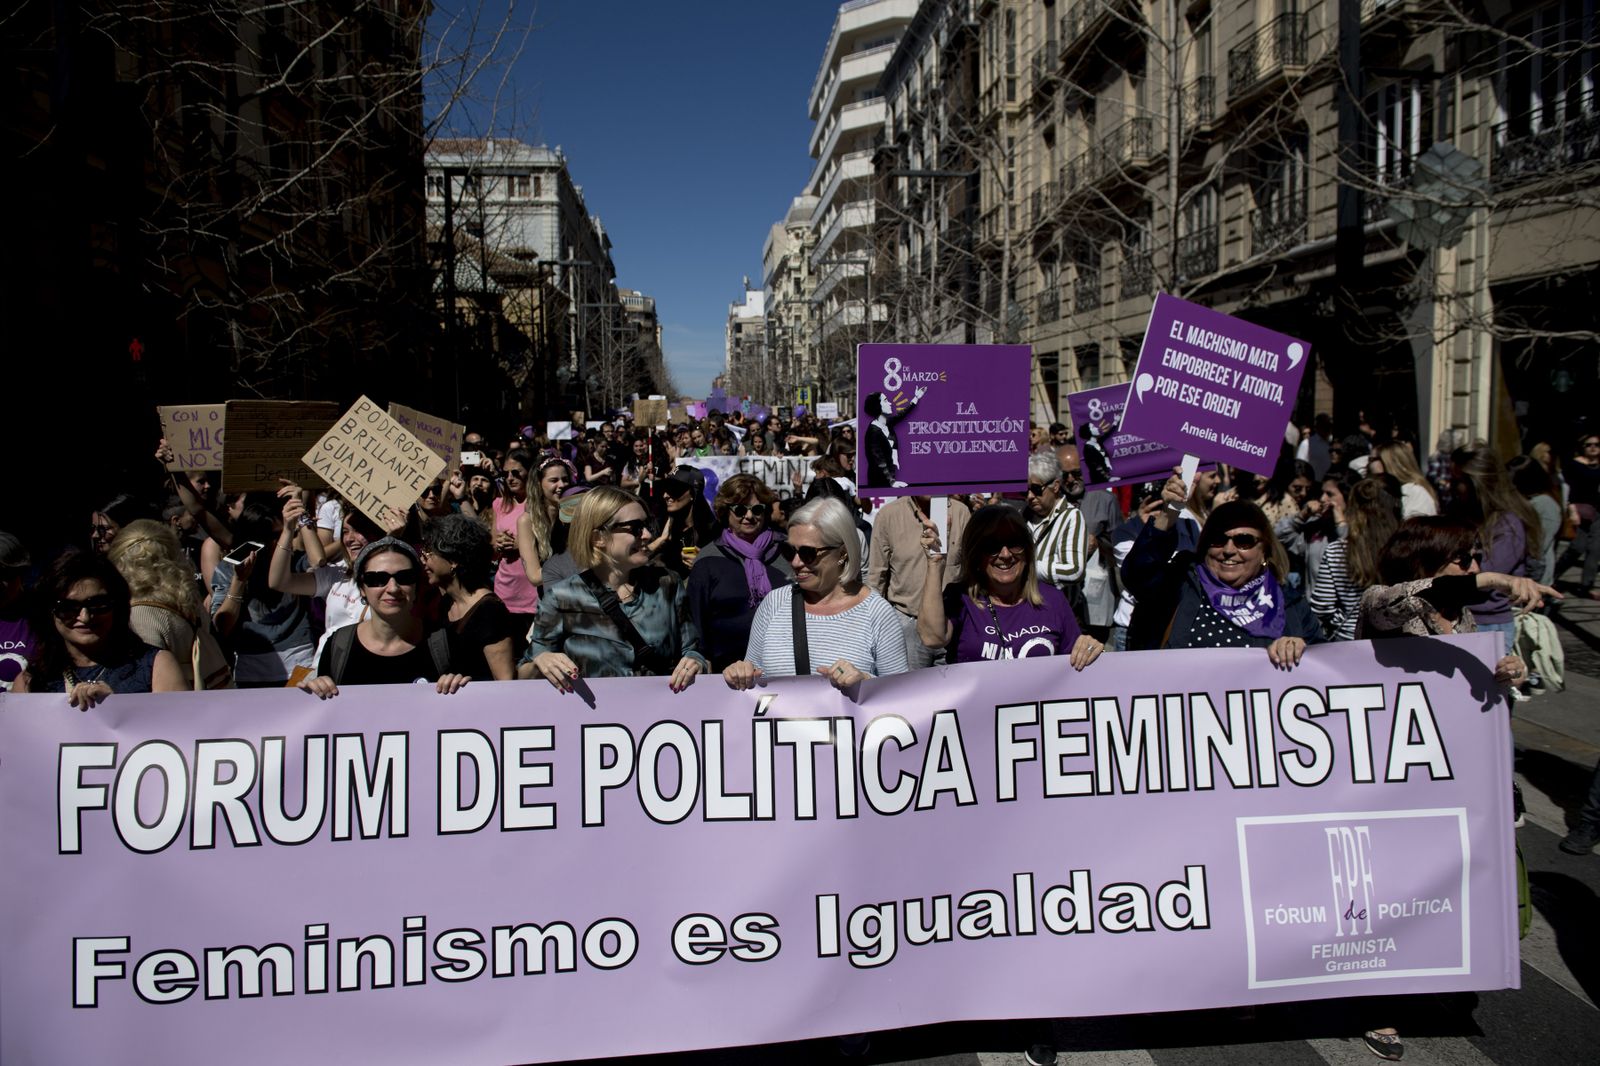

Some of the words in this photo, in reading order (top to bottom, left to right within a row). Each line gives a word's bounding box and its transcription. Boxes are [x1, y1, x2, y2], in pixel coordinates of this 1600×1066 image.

[1169, 320, 1184, 342] EL
[1185, 324, 1248, 362] MACHISMO
[1248, 347, 1280, 372] MATA
[884, 357, 902, 392] 8
[902, 372, 939, 382] MARZO
[1161, 347, 1230, 387] EMPOBRECE
[1232, 372, 1242, 390] Y
[1240, 374, 1285, 407] ATONTA,
[956, 402, 978, 415] LA
[1087, 398, 1104, 421] 8
[1154, 376, 1178, 400] POR
[1178, 384, 1203, 408] ESE
[1202, 392, 1242, 420] ORDEN
[172, 411, 198, 422] CON
[908, 417, 1025, 435] PROSTITUCIÓN
[353, 401, 430, 470] PODEROSA
[910, 441, 932, 454] ES
[932, 440, 1018, 454] VIOLENCIA
[1112, 434, 1146, 446] FEM
[1180, 420, 1218, 443] Amelia
[1220, 433, 1268, 458] Valcárcel
[179, 452, 207, 468] NO
[323, 436, 374, 483] GUAPA
[386, 480, 397, 496] Y
[340, 418, 426, 491] BRILLANTE
[312, 451, 390, 522] VALIENTE
[984, 625, 1052, 642] GNADA
[57, 730, 410, 855] FORUM
[436, 724, 557, 836] DE
[580, 693, 978, 828] POLÍTICA
[996, 681, 1454, 804] FEMINISTA
[1264, 904, 1327, 925] FÓRUM
[1344, 900, 1368, 921] de
[1378, 898, 1453, 920] POLÍTICA
[72, 916, 640, 1010] Feminismo
[671, 912, 782, 966] es
[816, 864, 1211, 970] Igualdad
[1311, 937, 1397, 960] FEMINISTA
[1325, 956, 1387, 972] Granada
